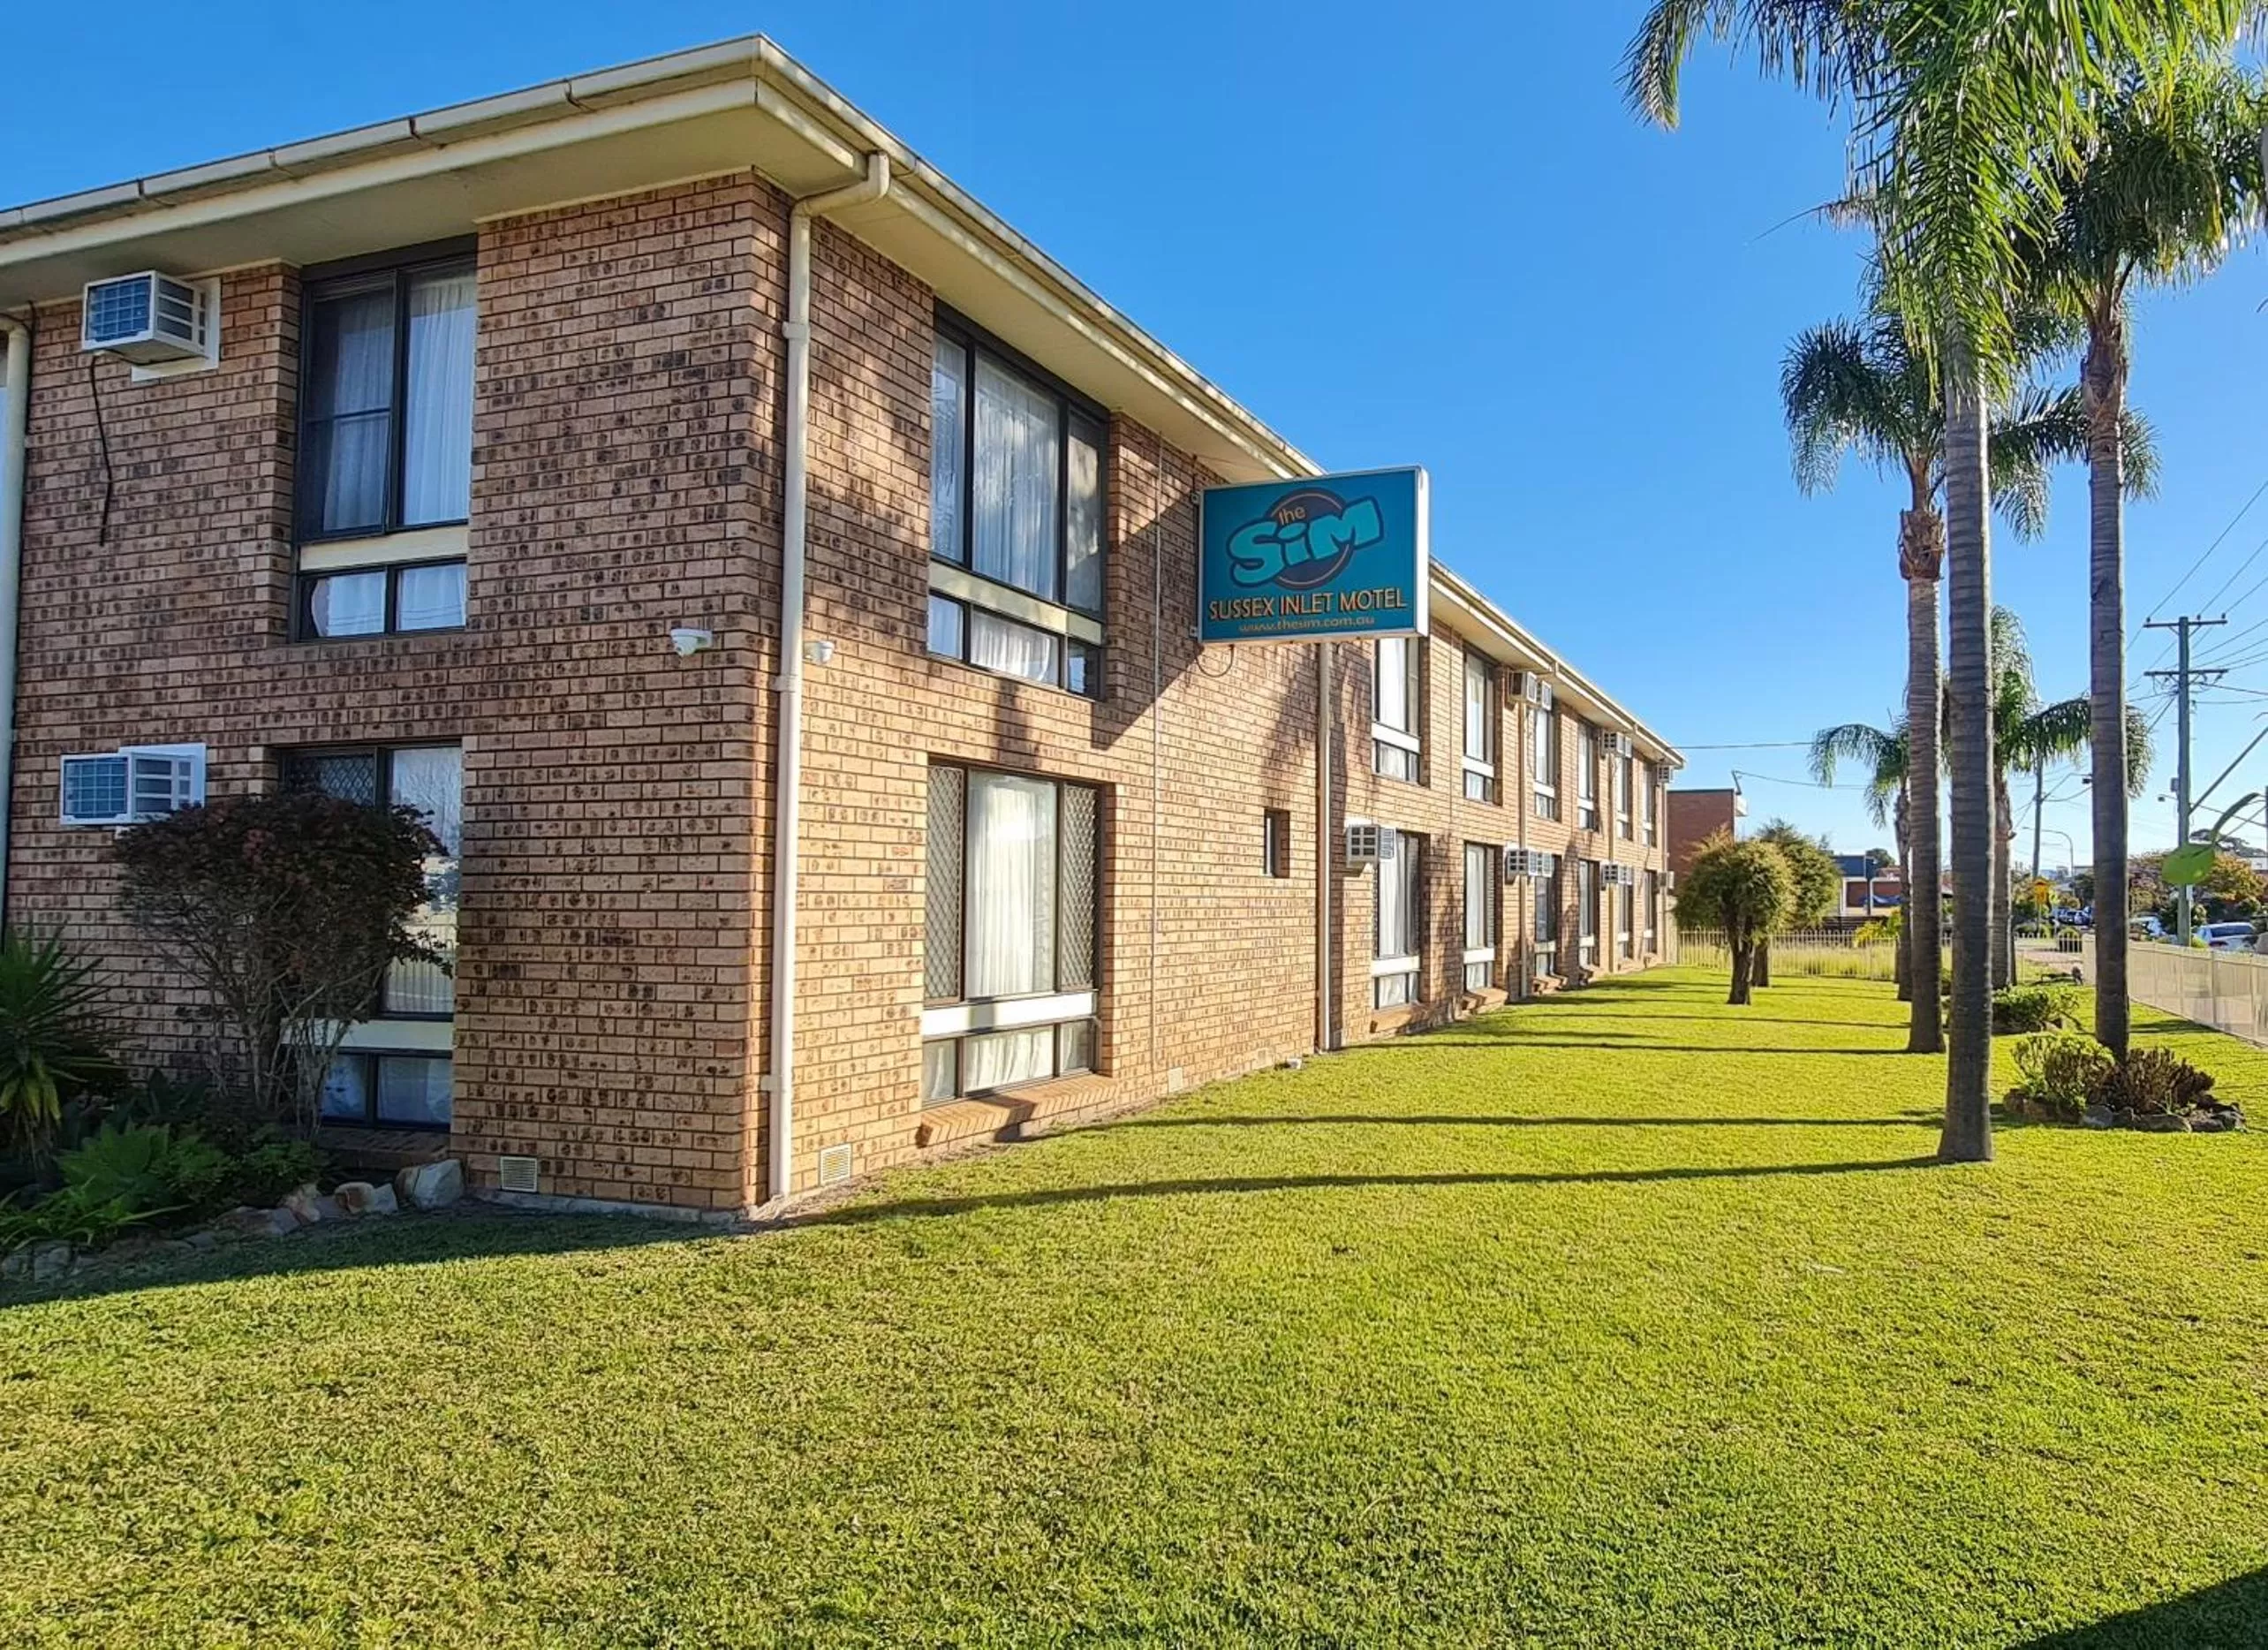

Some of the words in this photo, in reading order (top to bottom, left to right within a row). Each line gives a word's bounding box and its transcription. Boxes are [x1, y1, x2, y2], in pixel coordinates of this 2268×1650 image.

[1279, 506, 1306, 526] the
[1208, 596, 1274, 620] SUSSEX
[1281, 592, 1334, 616] INLET
[1339, 588, 1408, 611] MOTEL
